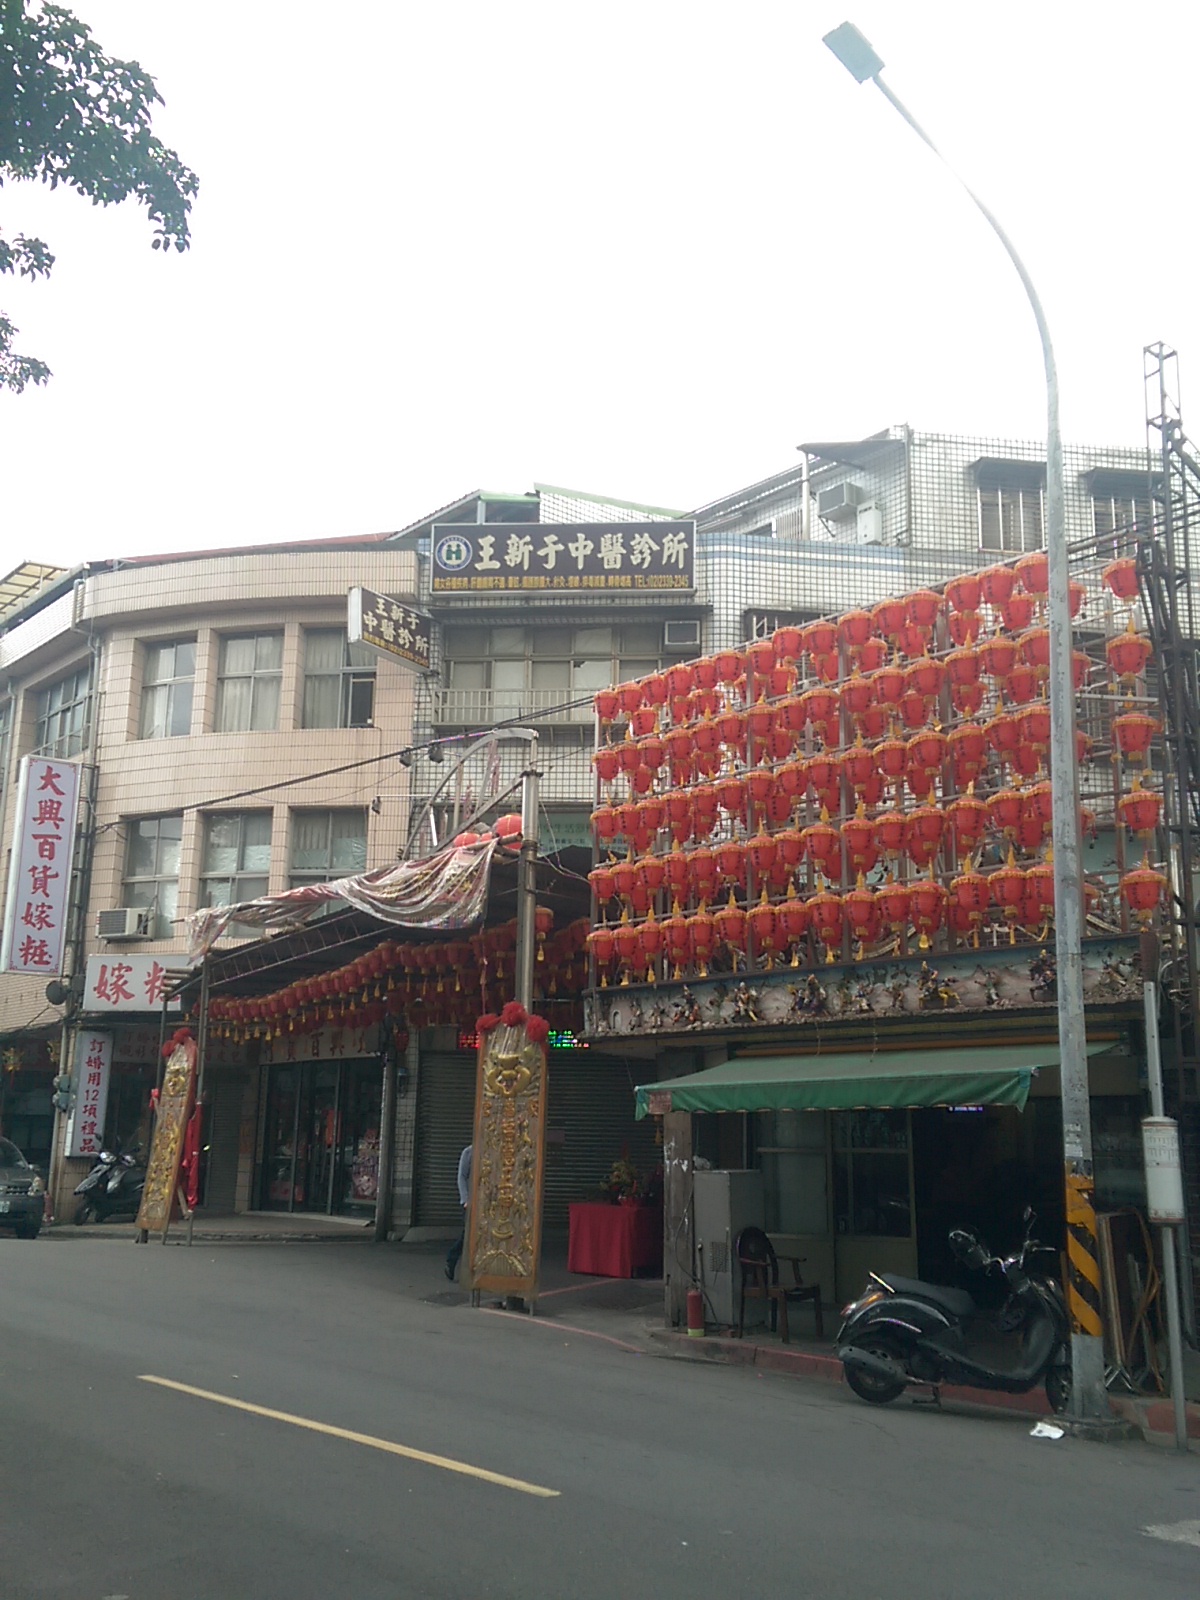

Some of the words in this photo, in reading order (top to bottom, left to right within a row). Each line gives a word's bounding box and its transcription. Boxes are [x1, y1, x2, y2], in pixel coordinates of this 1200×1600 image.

[474, 533, 689, 571] 王新于中醫診所
[363, 611, 430, 657] 中醫診所
[375, 597, 420, 630] 王新于
[79, 1038, 106, 1153] 訂婚用12項禮品
